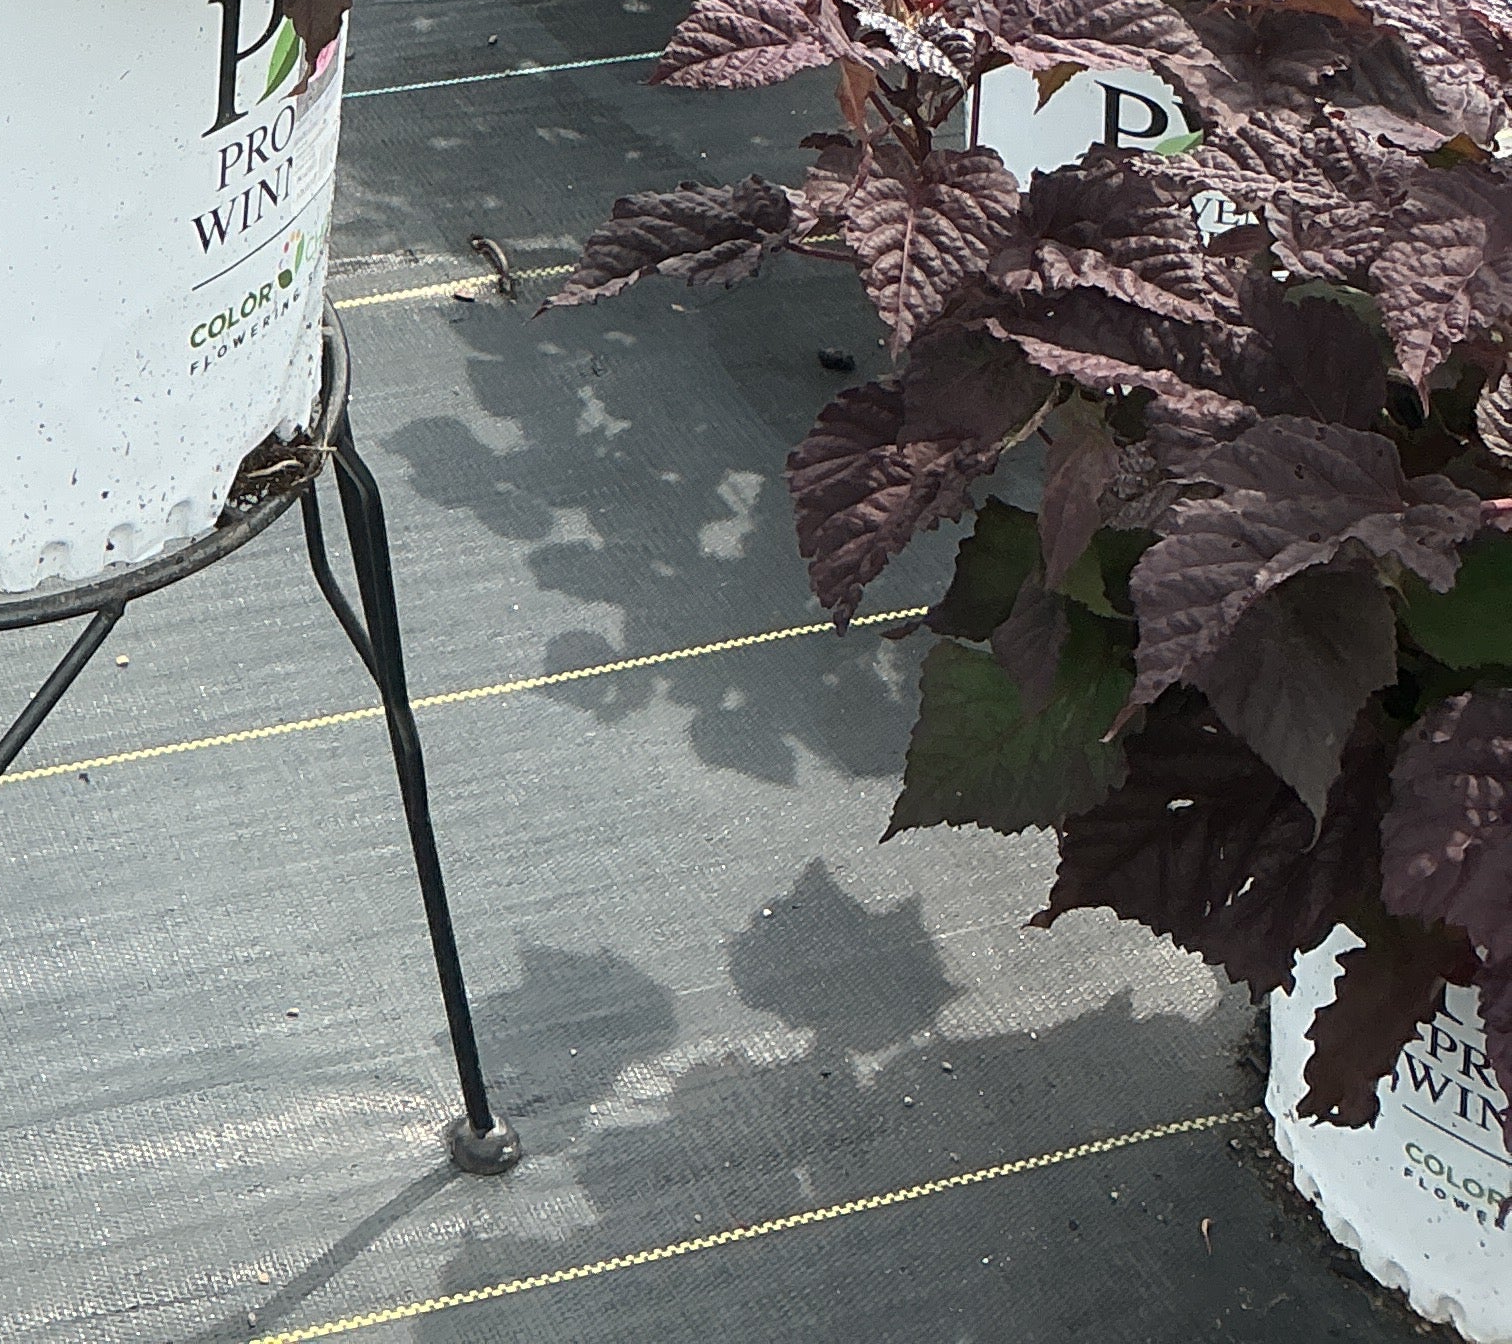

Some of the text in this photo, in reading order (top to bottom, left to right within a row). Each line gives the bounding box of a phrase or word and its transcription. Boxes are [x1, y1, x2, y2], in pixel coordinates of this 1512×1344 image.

[216, 105, 296, 192] PRO
[190, 282, 272, 349] COLOR
[190, 292, 300, 376] FLOWERING
[1402, 1165, 1488, 1227] FLOWE
